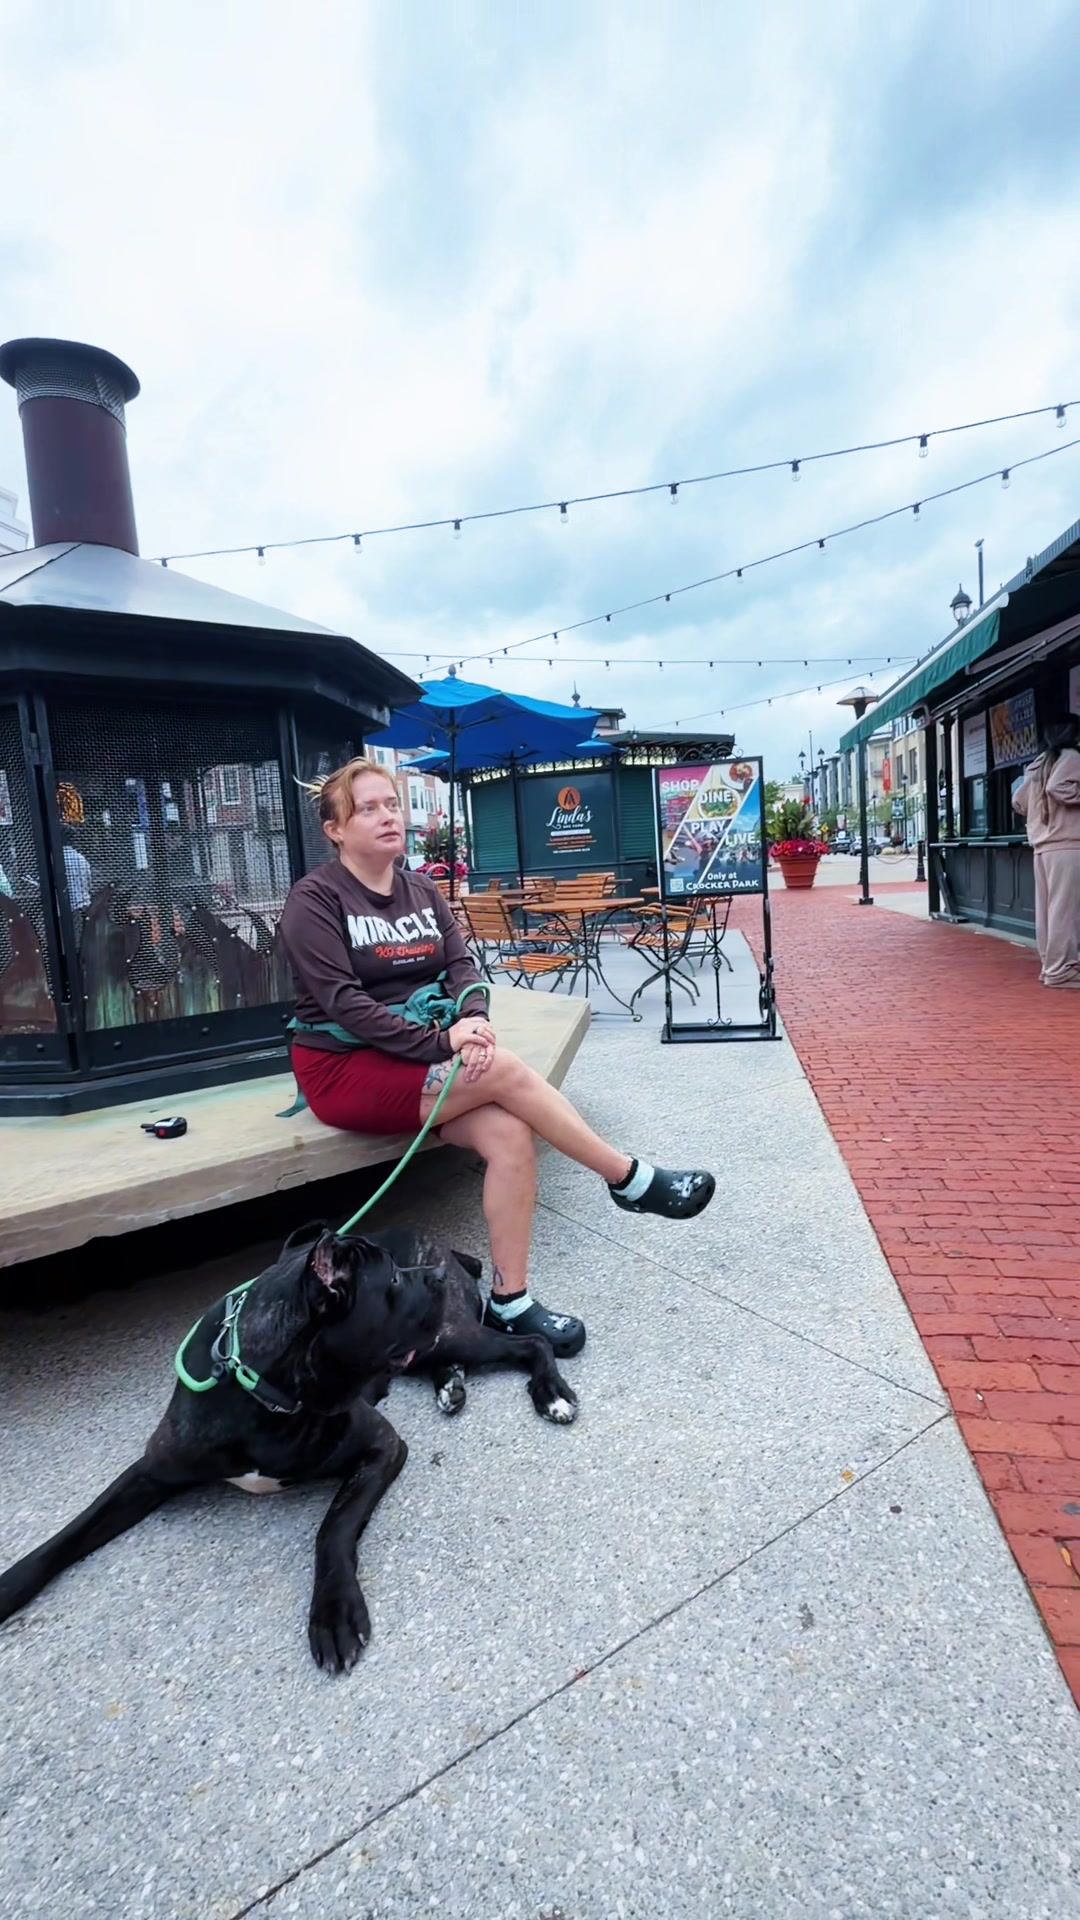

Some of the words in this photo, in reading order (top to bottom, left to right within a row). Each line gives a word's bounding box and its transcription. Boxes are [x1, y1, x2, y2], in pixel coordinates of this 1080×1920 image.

[545, 805, 594, 830] Linda's
[707, 872, 726, 881] Only
[686, 881, 731, 891] CROCKER
[732, 879, 759, 889] PARK
